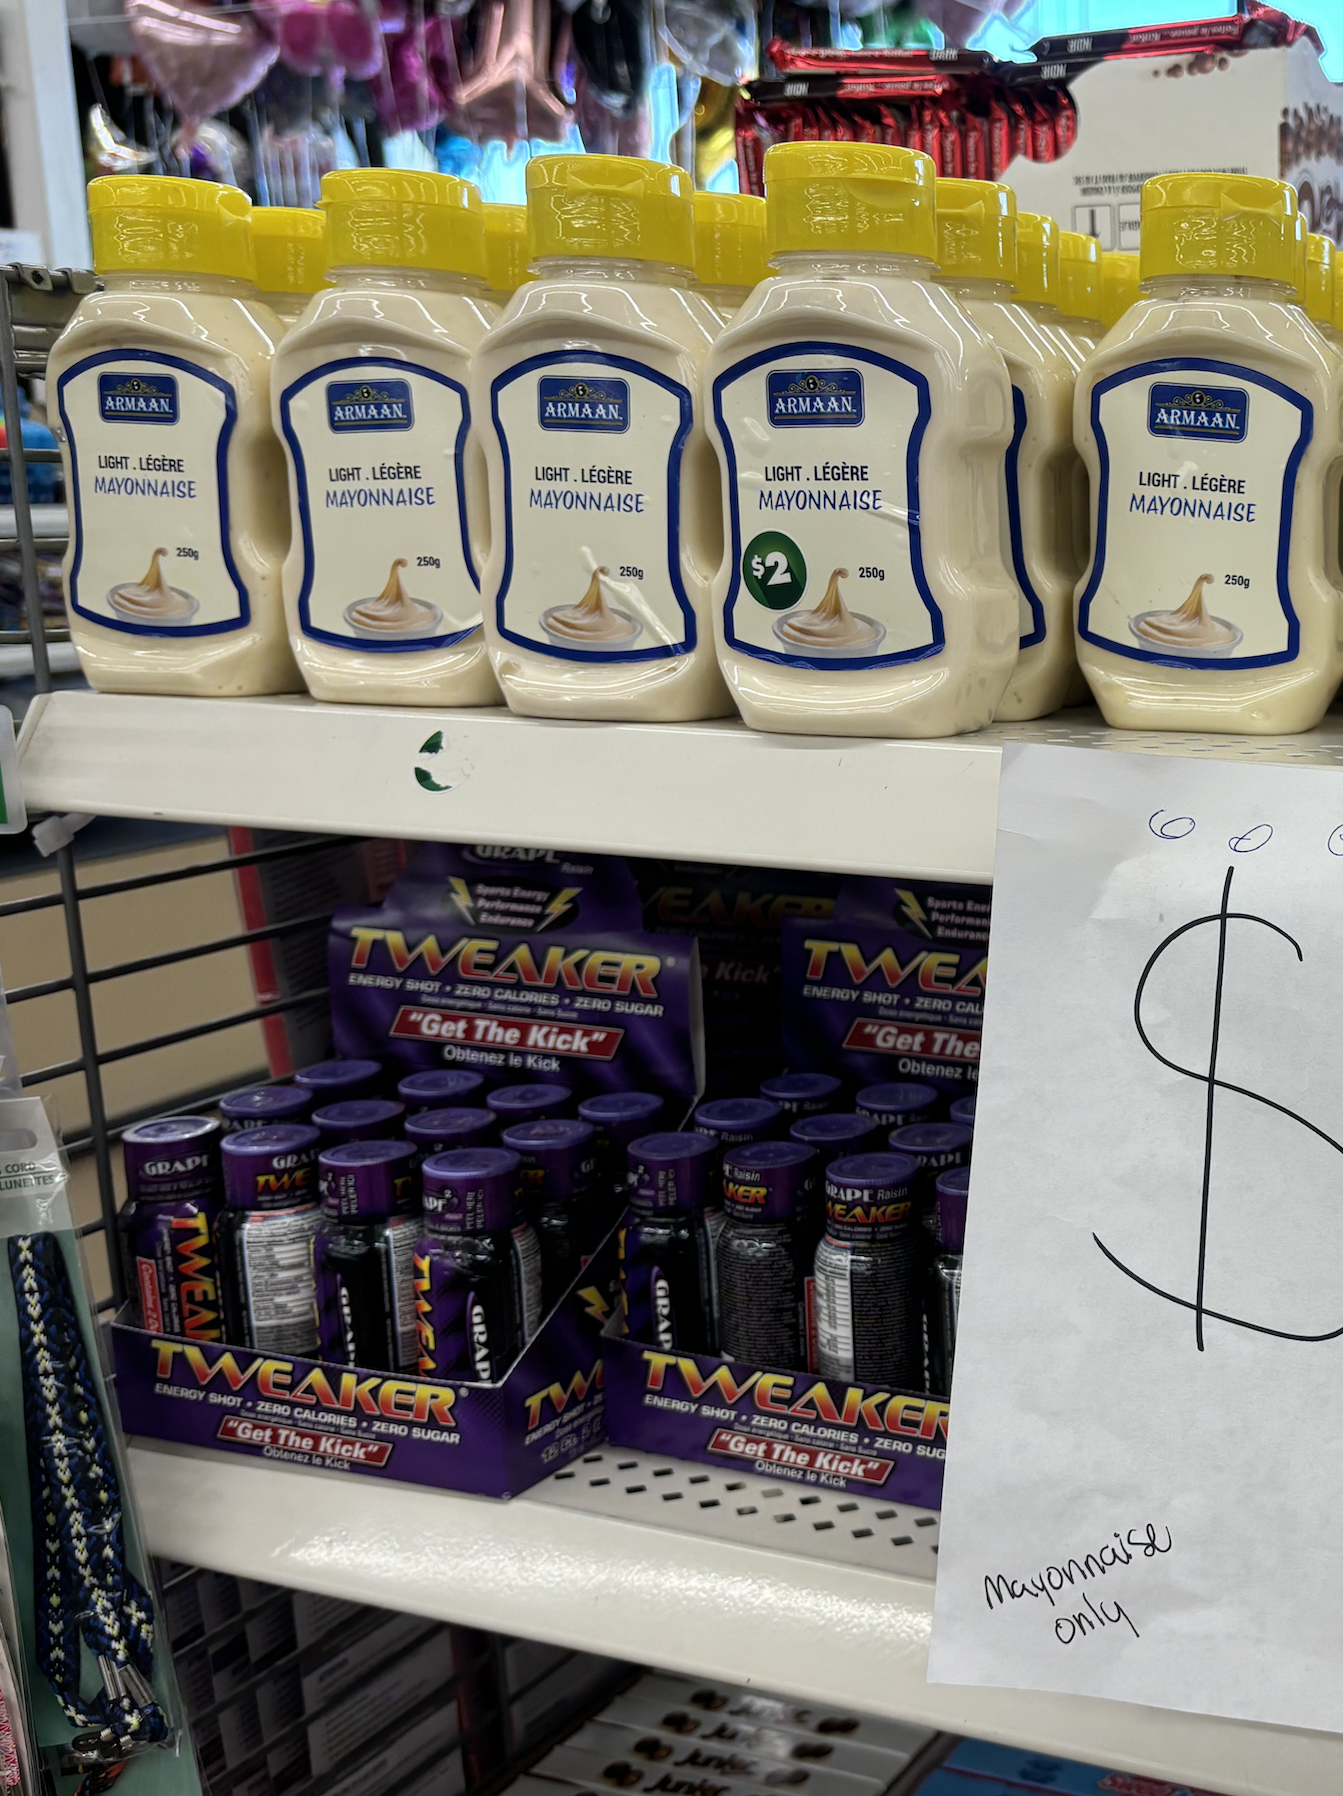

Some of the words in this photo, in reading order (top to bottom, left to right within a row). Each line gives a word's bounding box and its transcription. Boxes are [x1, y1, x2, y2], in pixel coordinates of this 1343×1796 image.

[105, 396, 172, 414] ARMAAN
[333, 404, 405, 421] ARMAAN
[545, 401, 621, 420] ARMAAN
[775, 396, 854, 415] ARMAAN
[1155, 407, 1238, 430] ARMAAN
[99, 455, 129, 469] LIGHT
[139, 455, 184, 472] LÉGÈRE
[329, 467, 361, 481] LIGHT
[372, 463, 421, 480] LÉGÈRE
[765, 466, 802, 481] LIGHT
[814, 462, 868, 481] LÉGÈRE
[536, 467, 569, 481] LIGHT
[582, 466, 632, 484] LÉGÈRE
[1139, 472, 1179, 488] LIGHT
[1192, 473, 1245, 494] LÉGÈRE
[95, 476, 196, 498] MAYONNAISE
[326, 487, 435, 507] MAYONNAISE
[530, 489, 644, 513] MAYONNAISE
[760, 490, 881, 510] MAYONNAISE
[1130, 493, 1256, 522] MAYONNAISE
[177, 548, 199, 560] 250g
[417, 557, 440, 568] 250g
[620, 566, 643, 580] 250g
[752, 551, 794, 587] $2
[859, 567, 884, 581] 250g
[1225, 575, 1249, 588] 250g
[511, 886, 551, 902] Energy
[476, 898, 543, 914] Performance
[643, 885, 836, 929] EAKER
[479, 912, 535, 928] Endurance
[351, 927, 661, 998] TWEAKER
[349, 973, 403, 990] ENERGY
[405, 980, 442, 993] SHOT
[455, 984, 491, 999] ZERO
[494, 988, 560, 1006] CALORIES
[574, 996, 611, 1011] ZERO
[614, 1001, 664, 1017] SUGAR
[803, 984, 859, 1001] ENERGY
[863, 990, 900, 1005] SHOT
[914, 996, 952, 1010] ZERO
[474, 1019, 521, 1045] The
[933, 1032, 980, 1058] The
[443, 1045, 505, 1066] Obtenez
[509, 1055, 522, 1068] le
[527, 1055, 561, 1072] Kick
[898, 1058, 963, 1079] Obtenez
[734, 1166, 761, 1182] Raisin
[877, 1187, 908, 1201] Raisin
[471, 1304, 492, 1382] GRAP
[152, 1339, 456, 1427] TWEAKER
[642, 1350, 950, 1441] TWEAKER
[154, 1383, 206, 1400] ENERGY
[208, 1392, 243, 1408] SHOT
[256, 1400, 291, 1416] ZERO
[294, 1407, 358, 1428] CALORIES
[372, 1420, 408, 1437] ZERO
[411, 1427, 461, 1445] SUGAR
[644, 1394, 698, 1413] ENERGY
[702, 1405, 738, 1421] SHOT
[751, 1415, 788, 1430] ZERO
[791, 1421, 859, 1443] CALORIES
[874, 1437, 912, 1454] ZERO
[278, 1430, 314, 1450] The
[262, 1446, 309, 1463] Obtenez
[311, 1455, 323, 1466] le
[325, 1454, 351, 1470] Kick
[772, 1444, 810, 1465] The
[755, 1460, 803, 1479] Obtenez
[807, 1470, 818, 1483] le
[820, 1473, 847, 1488] Kick
[984, 1523, 1172, 1609] Mayonnaise
[1055, 1592, 1140, 1644] only
